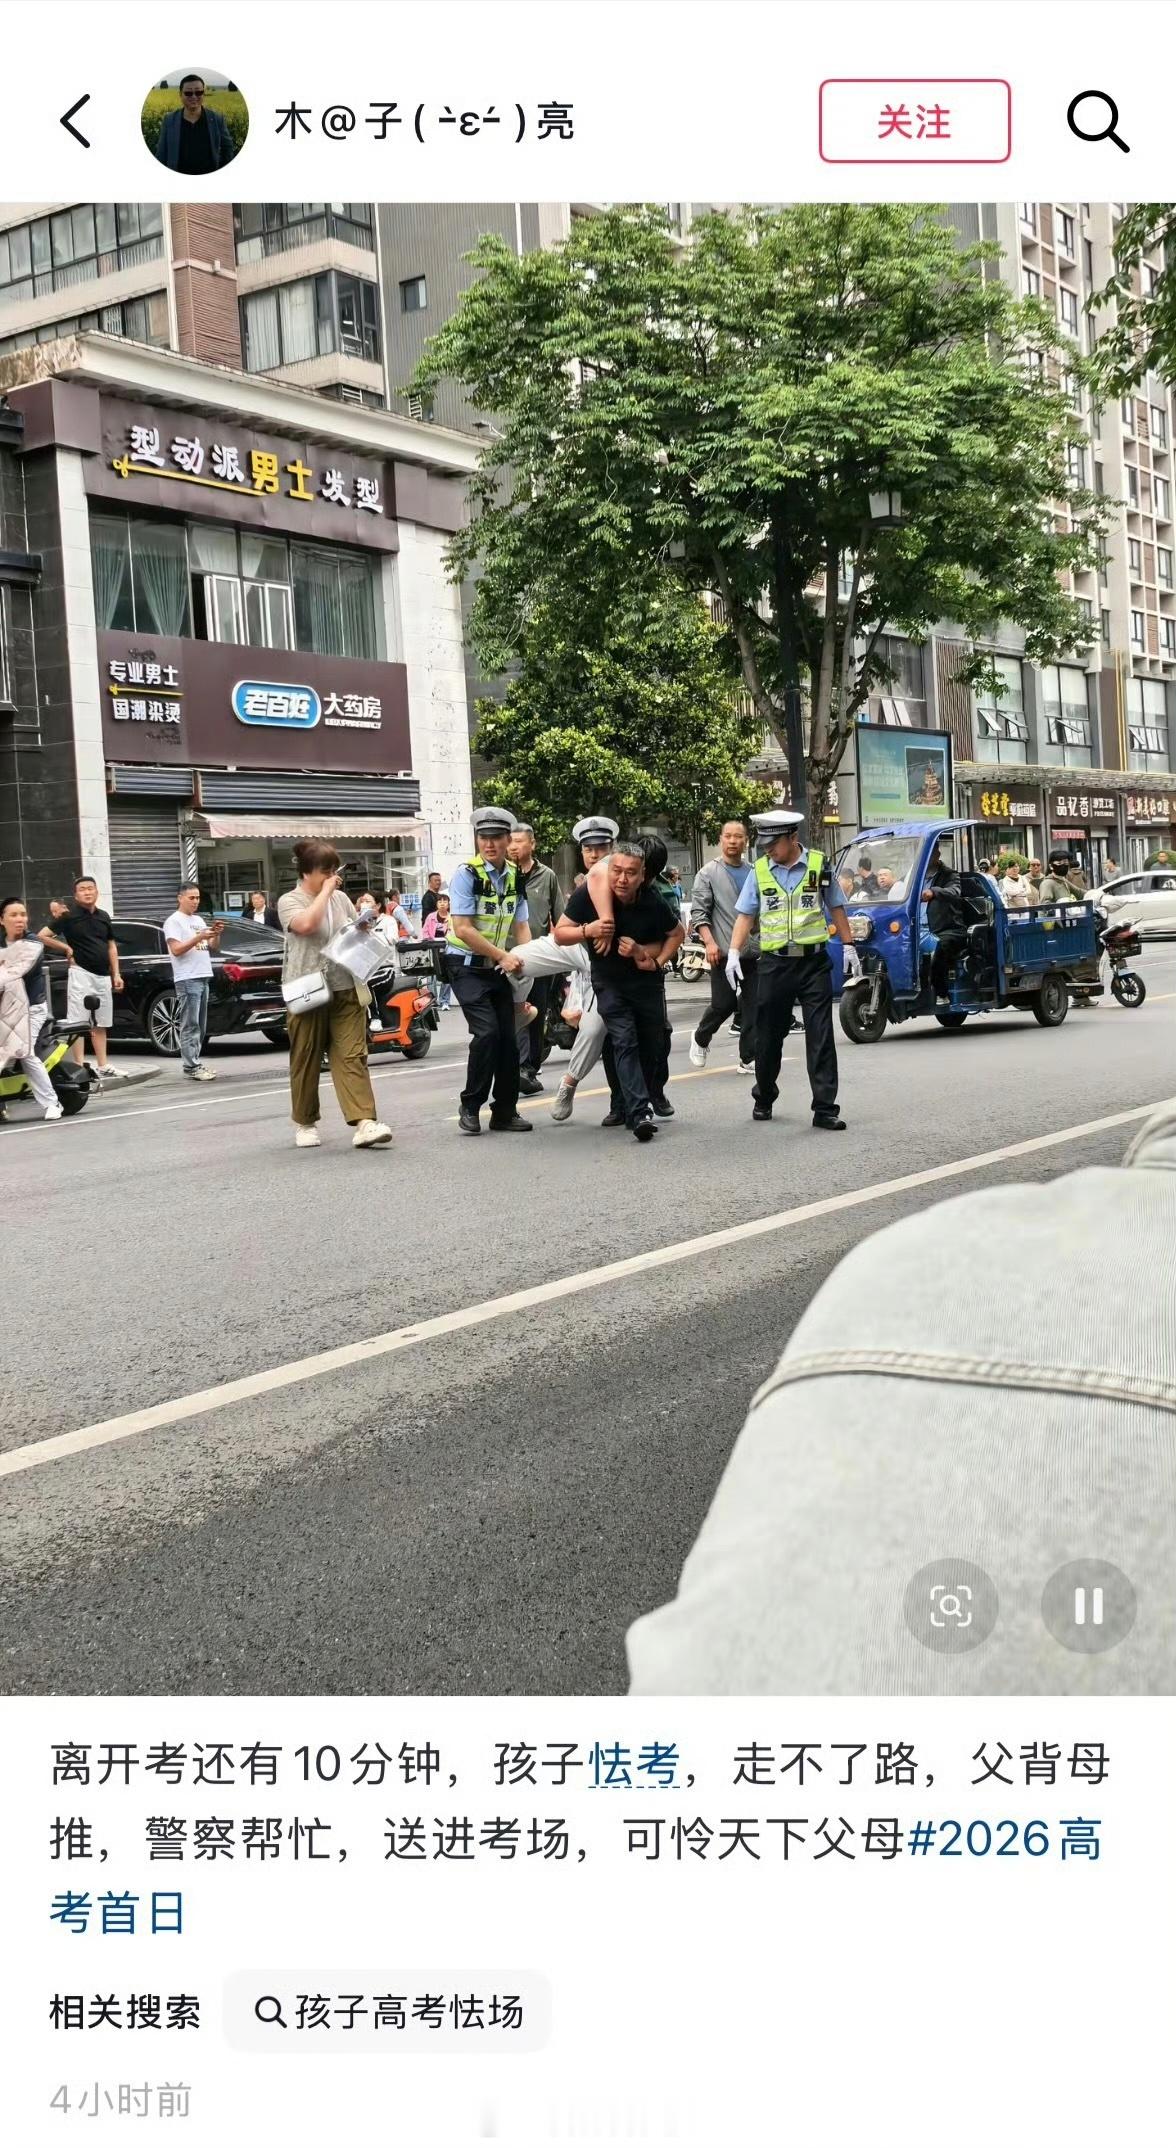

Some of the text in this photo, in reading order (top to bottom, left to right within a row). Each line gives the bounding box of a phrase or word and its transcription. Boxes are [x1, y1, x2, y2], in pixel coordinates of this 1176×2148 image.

[130, 424, 384, 514] 型动派男士发型
[109, 660, 179, 686] 专业男士
[112, 698, 181, 723] 国潮染烫
[323, 692, 382, 718] 大药房
